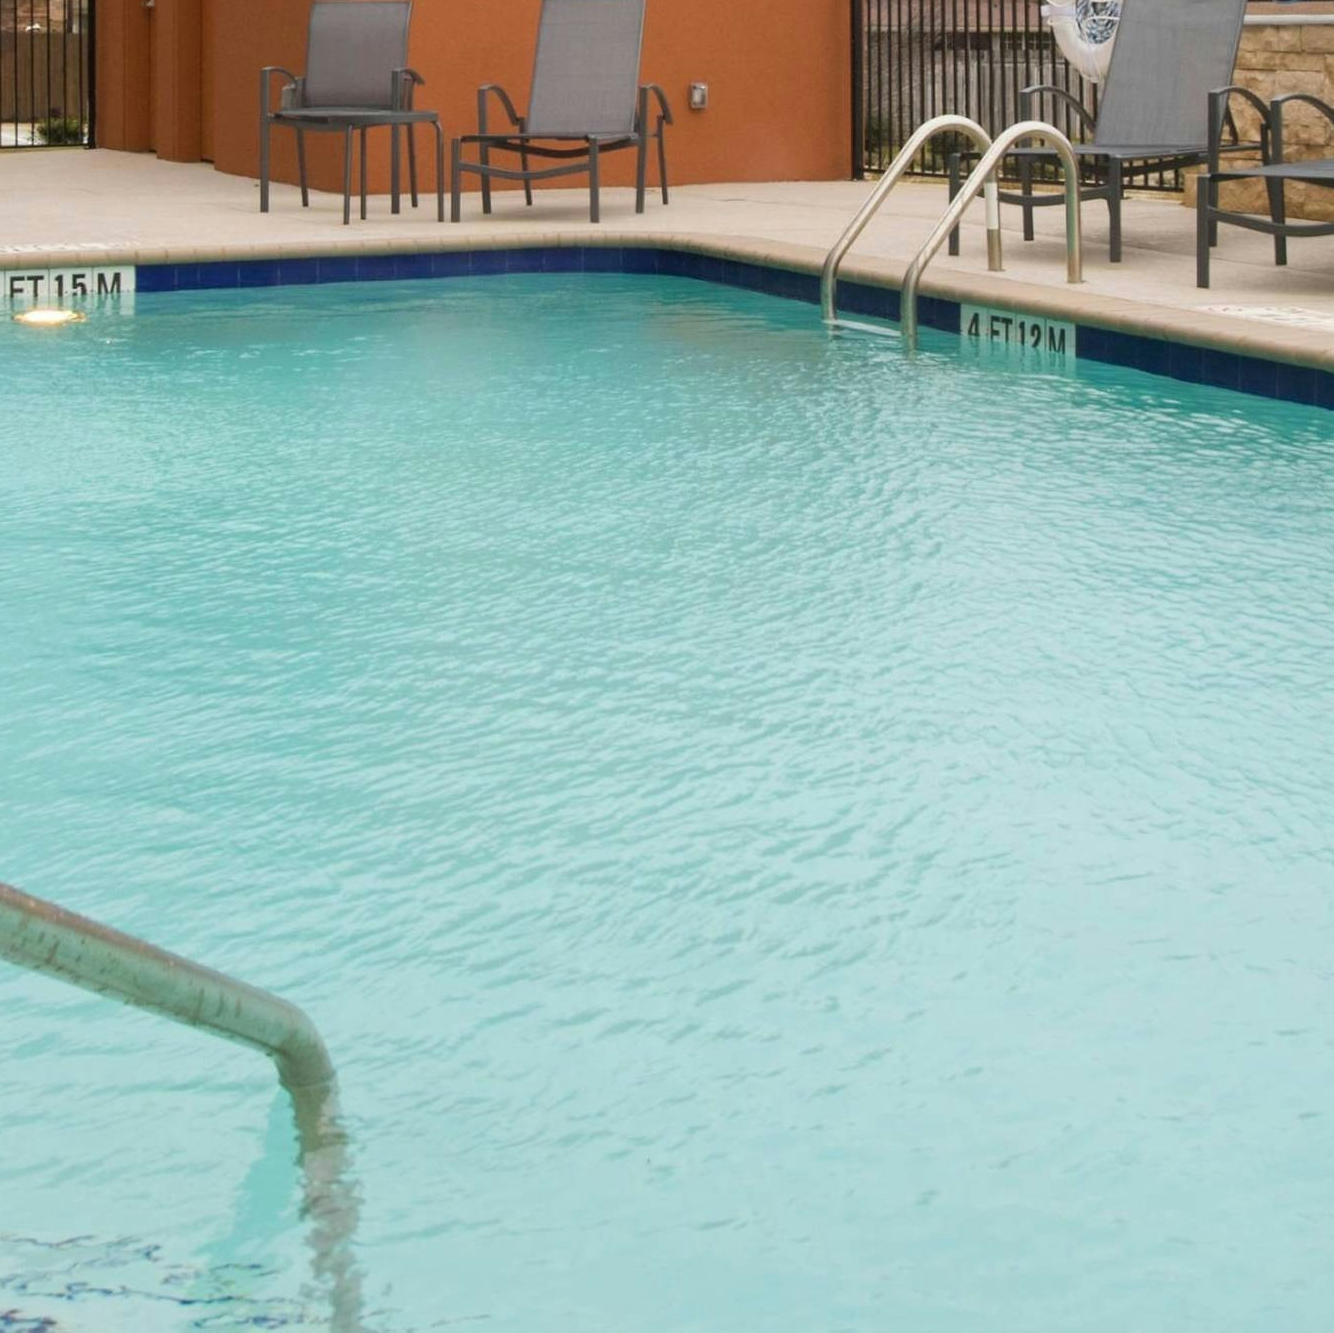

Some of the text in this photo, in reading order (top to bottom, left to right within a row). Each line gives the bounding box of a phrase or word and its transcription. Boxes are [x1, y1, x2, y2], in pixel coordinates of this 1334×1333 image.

[10, 275, 44, 298] FT
[968, 312, 980, 337] 4
[990, 315, 1013, 343] FT
